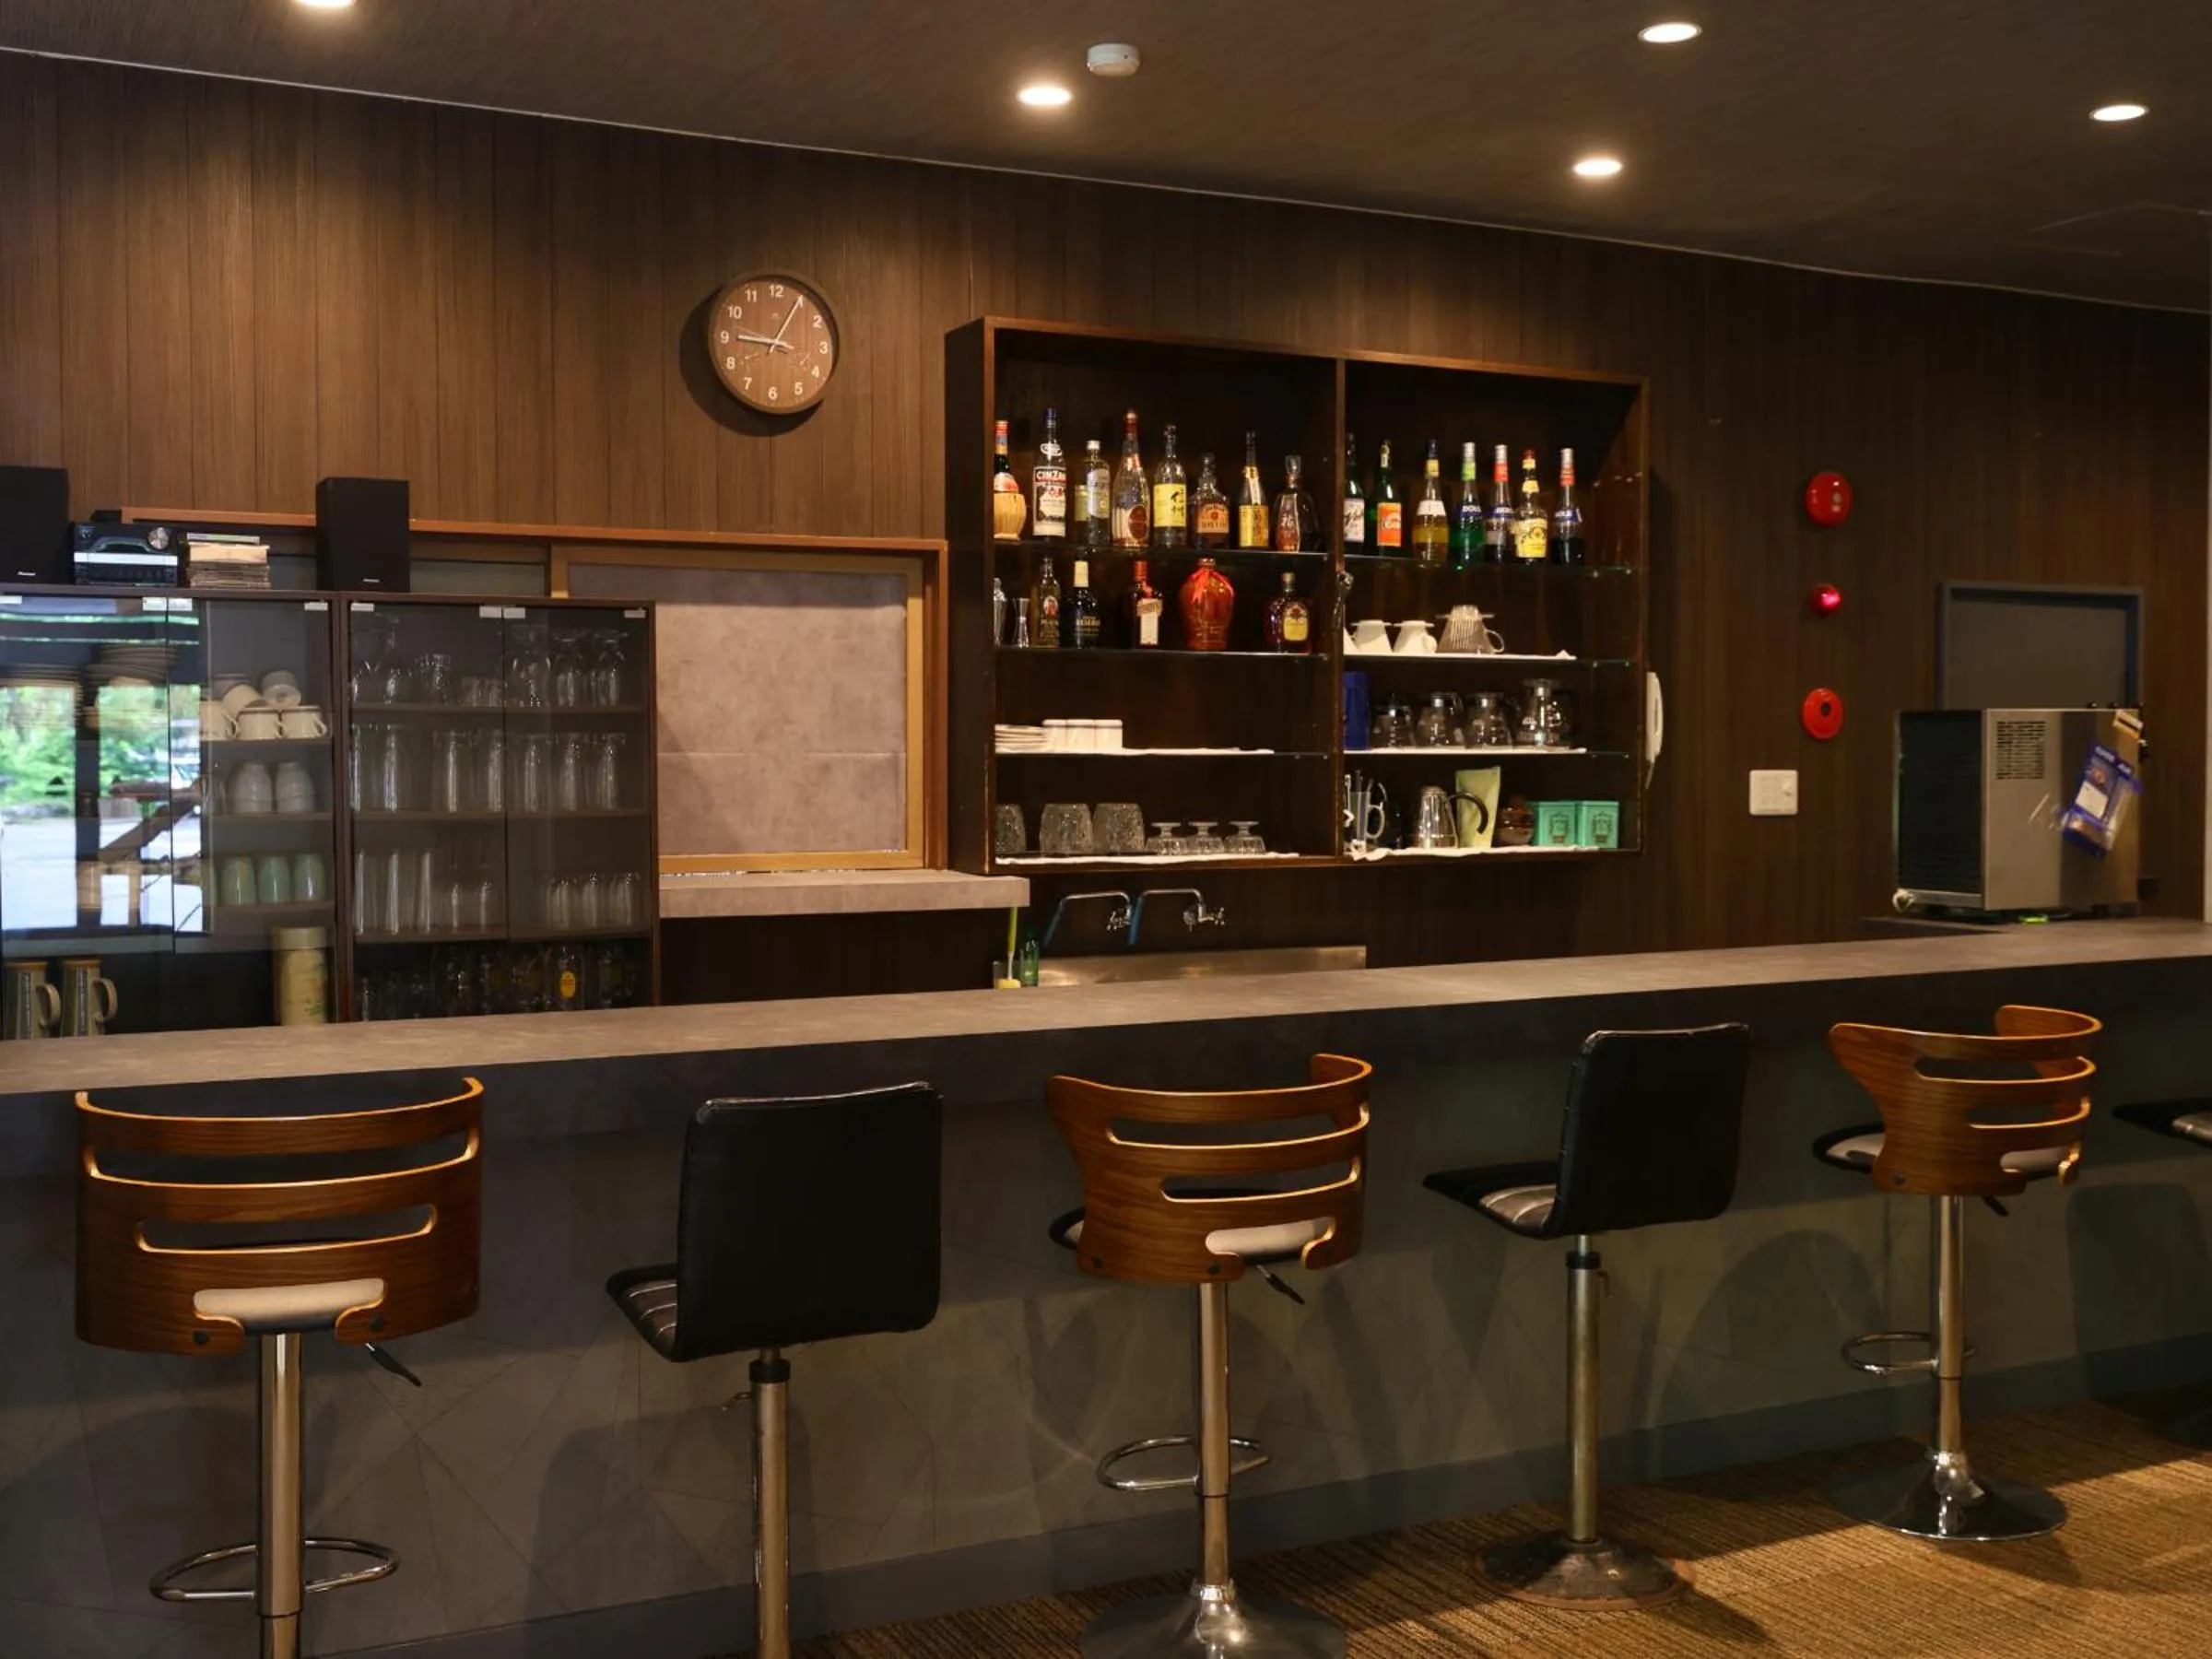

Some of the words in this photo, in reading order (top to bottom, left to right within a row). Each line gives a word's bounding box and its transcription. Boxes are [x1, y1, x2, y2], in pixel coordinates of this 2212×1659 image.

[745, 289, 758, 302] 11
[769, 284, 783, 298] 12
[727, 306, 742, 319] 10
[813, 315, 822, 328] 2
[720, 331, 729, 344] 9
[819, 341, 829, 354] 3
[726, 357, 735, 370] 8
[811, 365, 819, 378] 4
[744, 377, 752, 390] 7
[794, 382, 803, 395] 5
[768, 387, 777, 399] 6
